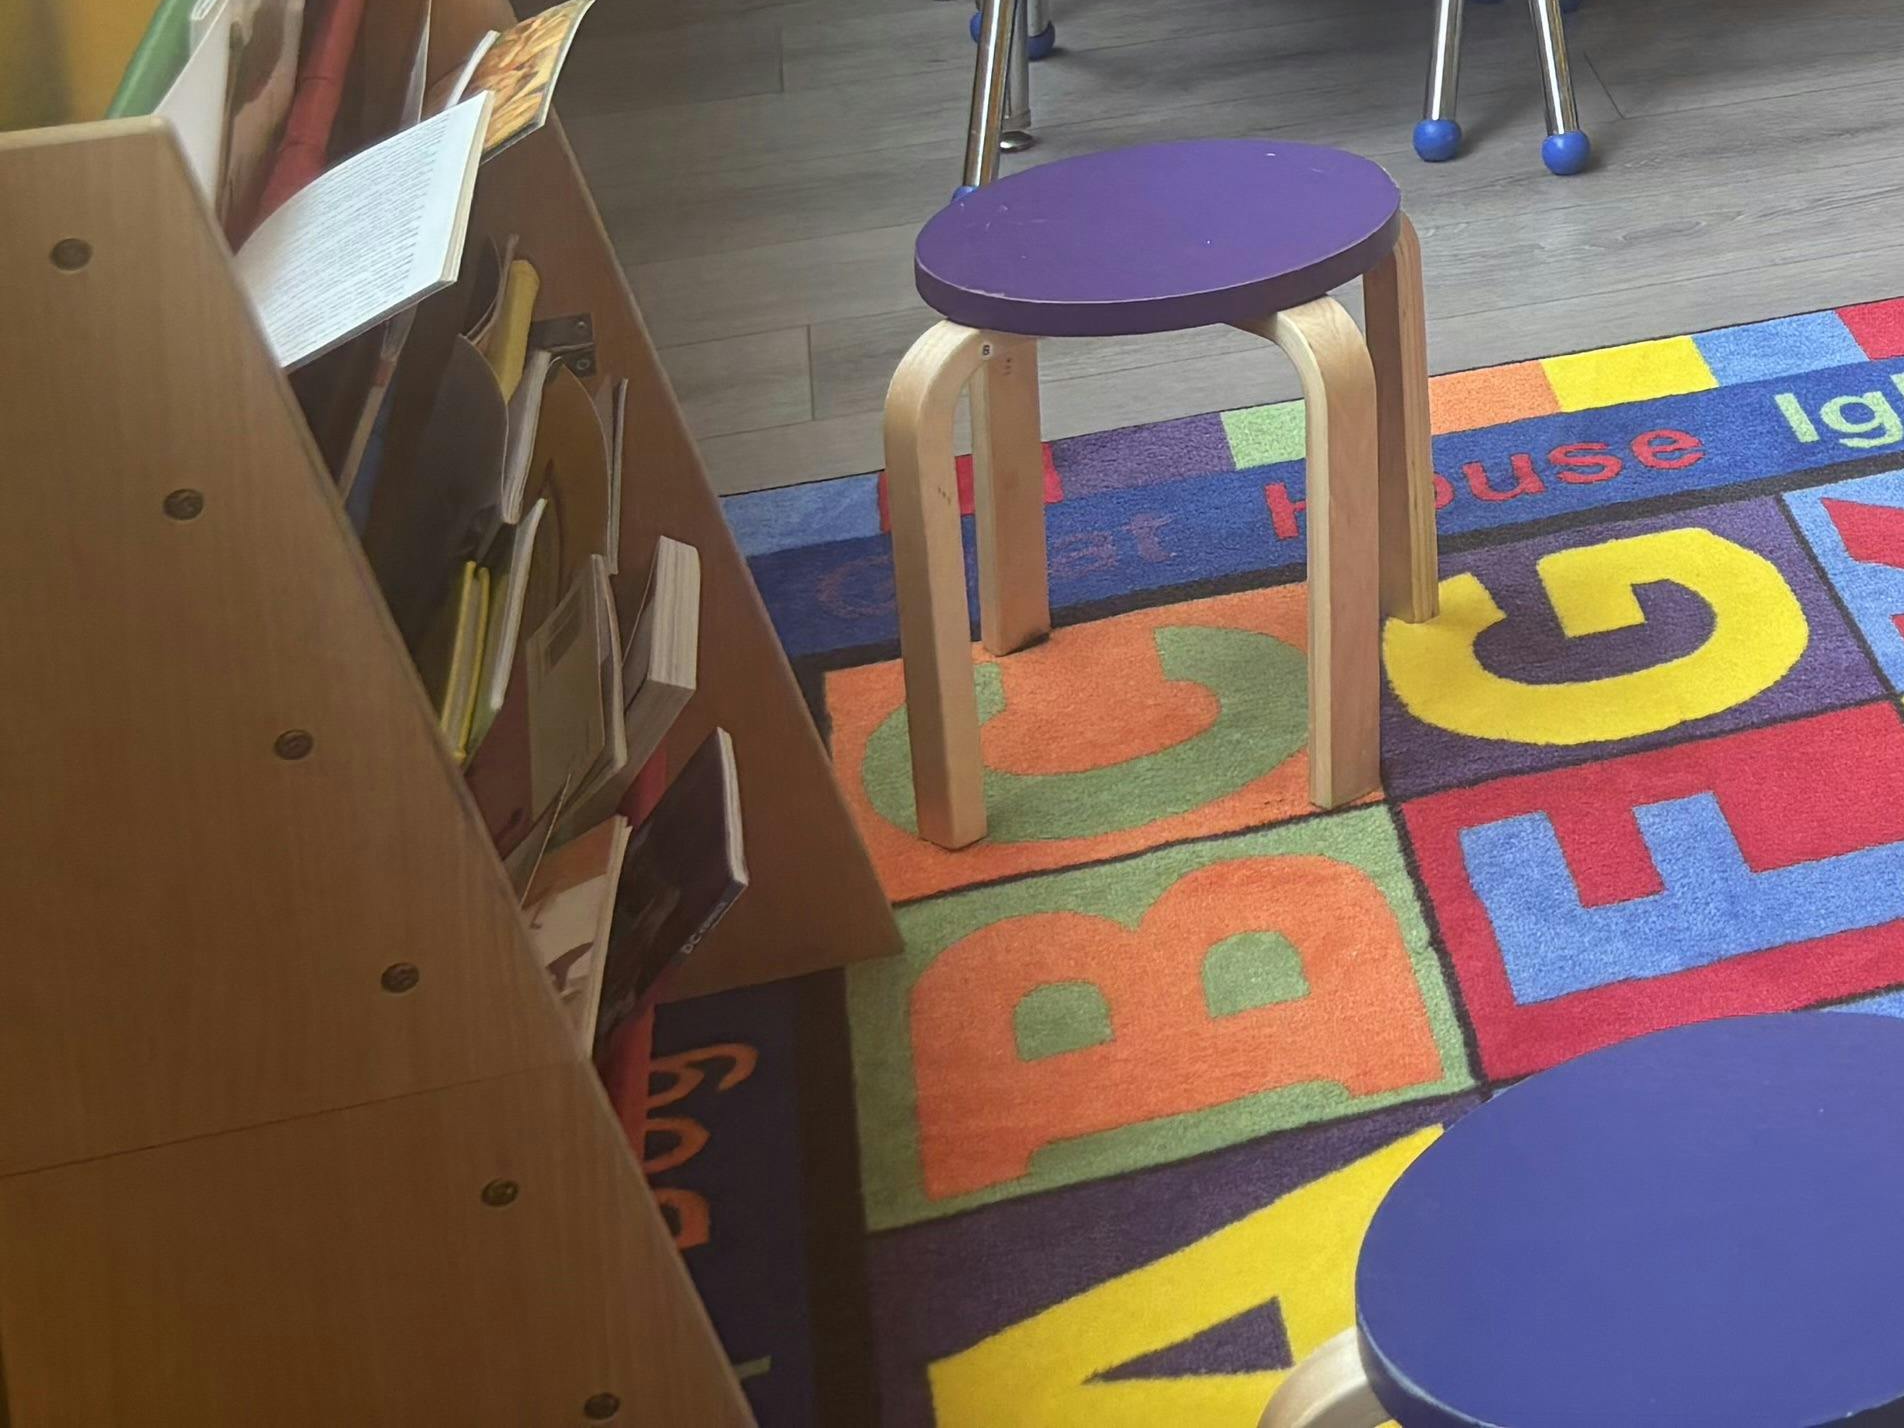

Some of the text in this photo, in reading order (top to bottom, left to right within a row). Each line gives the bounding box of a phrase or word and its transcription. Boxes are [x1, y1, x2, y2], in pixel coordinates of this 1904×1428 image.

[861, 624, 1312, 845] C
[1384, 525, 1811, 748] G
[908, 853, 1442, 1200] B
